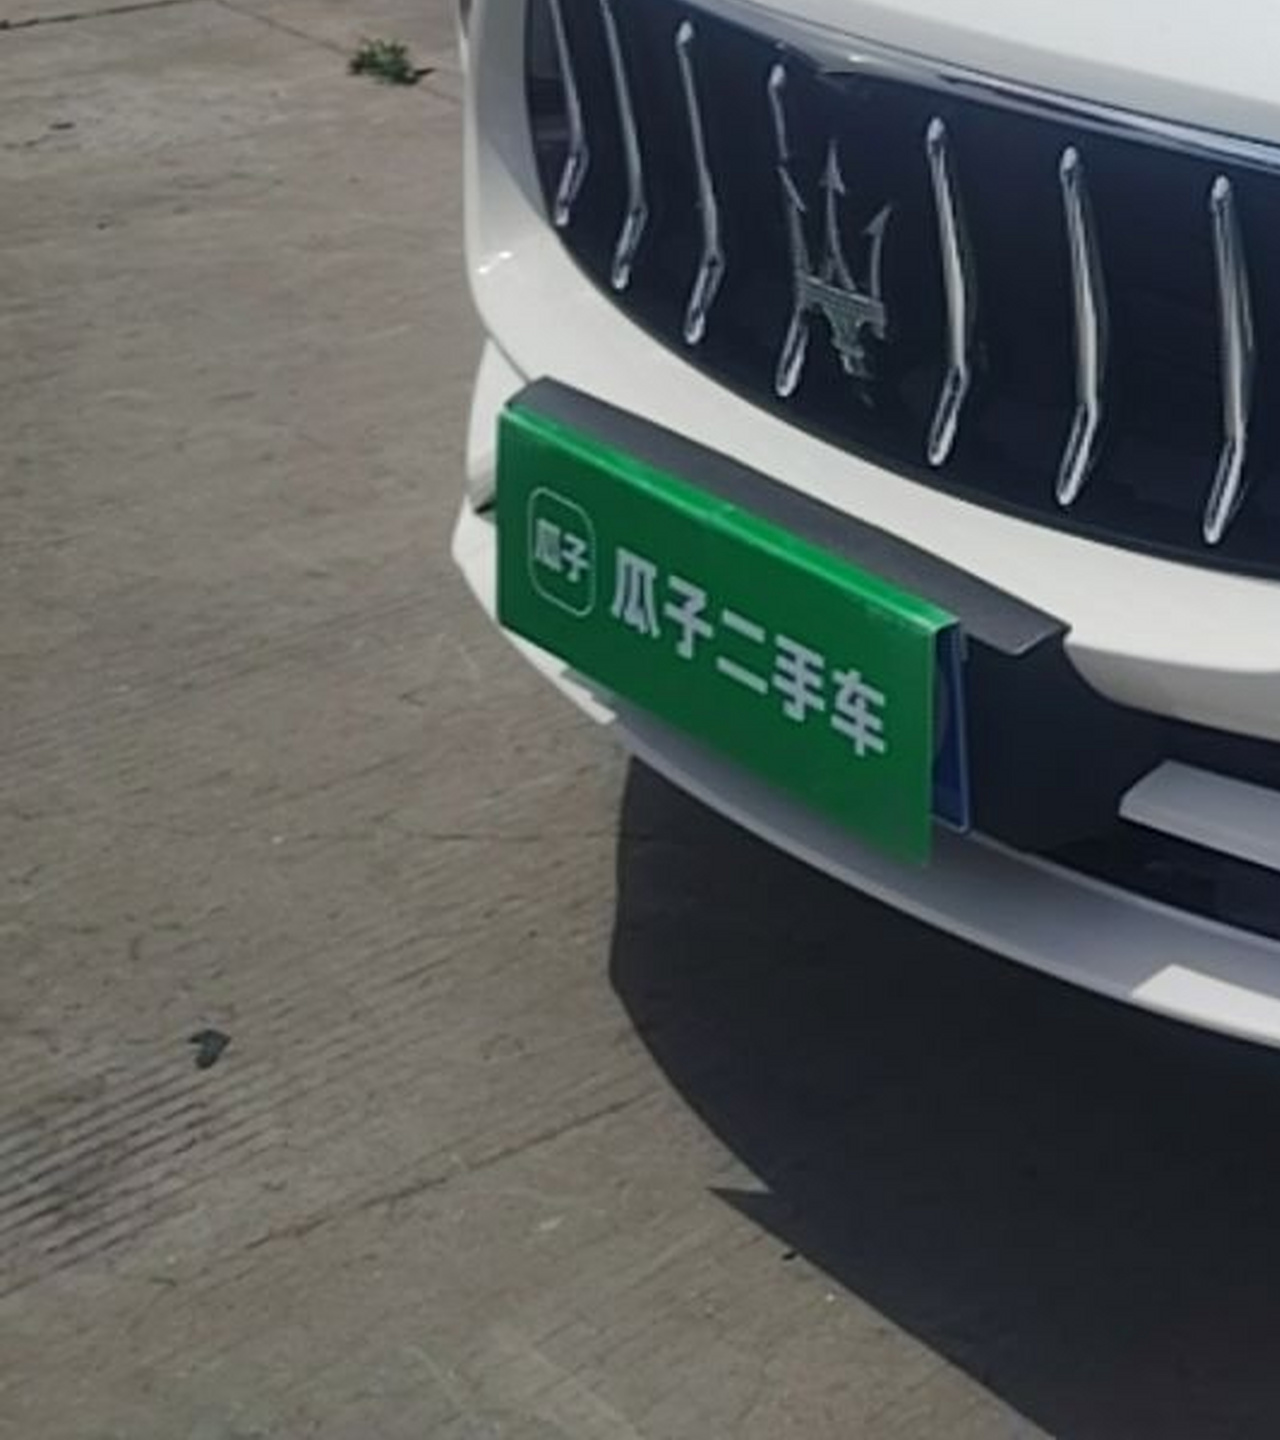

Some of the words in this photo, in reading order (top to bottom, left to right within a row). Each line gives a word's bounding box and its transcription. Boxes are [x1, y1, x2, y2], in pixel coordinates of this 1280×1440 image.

[534, 517, 589, 583] 瓜子
[610, 545, 886, 757] 瓜子二手车
